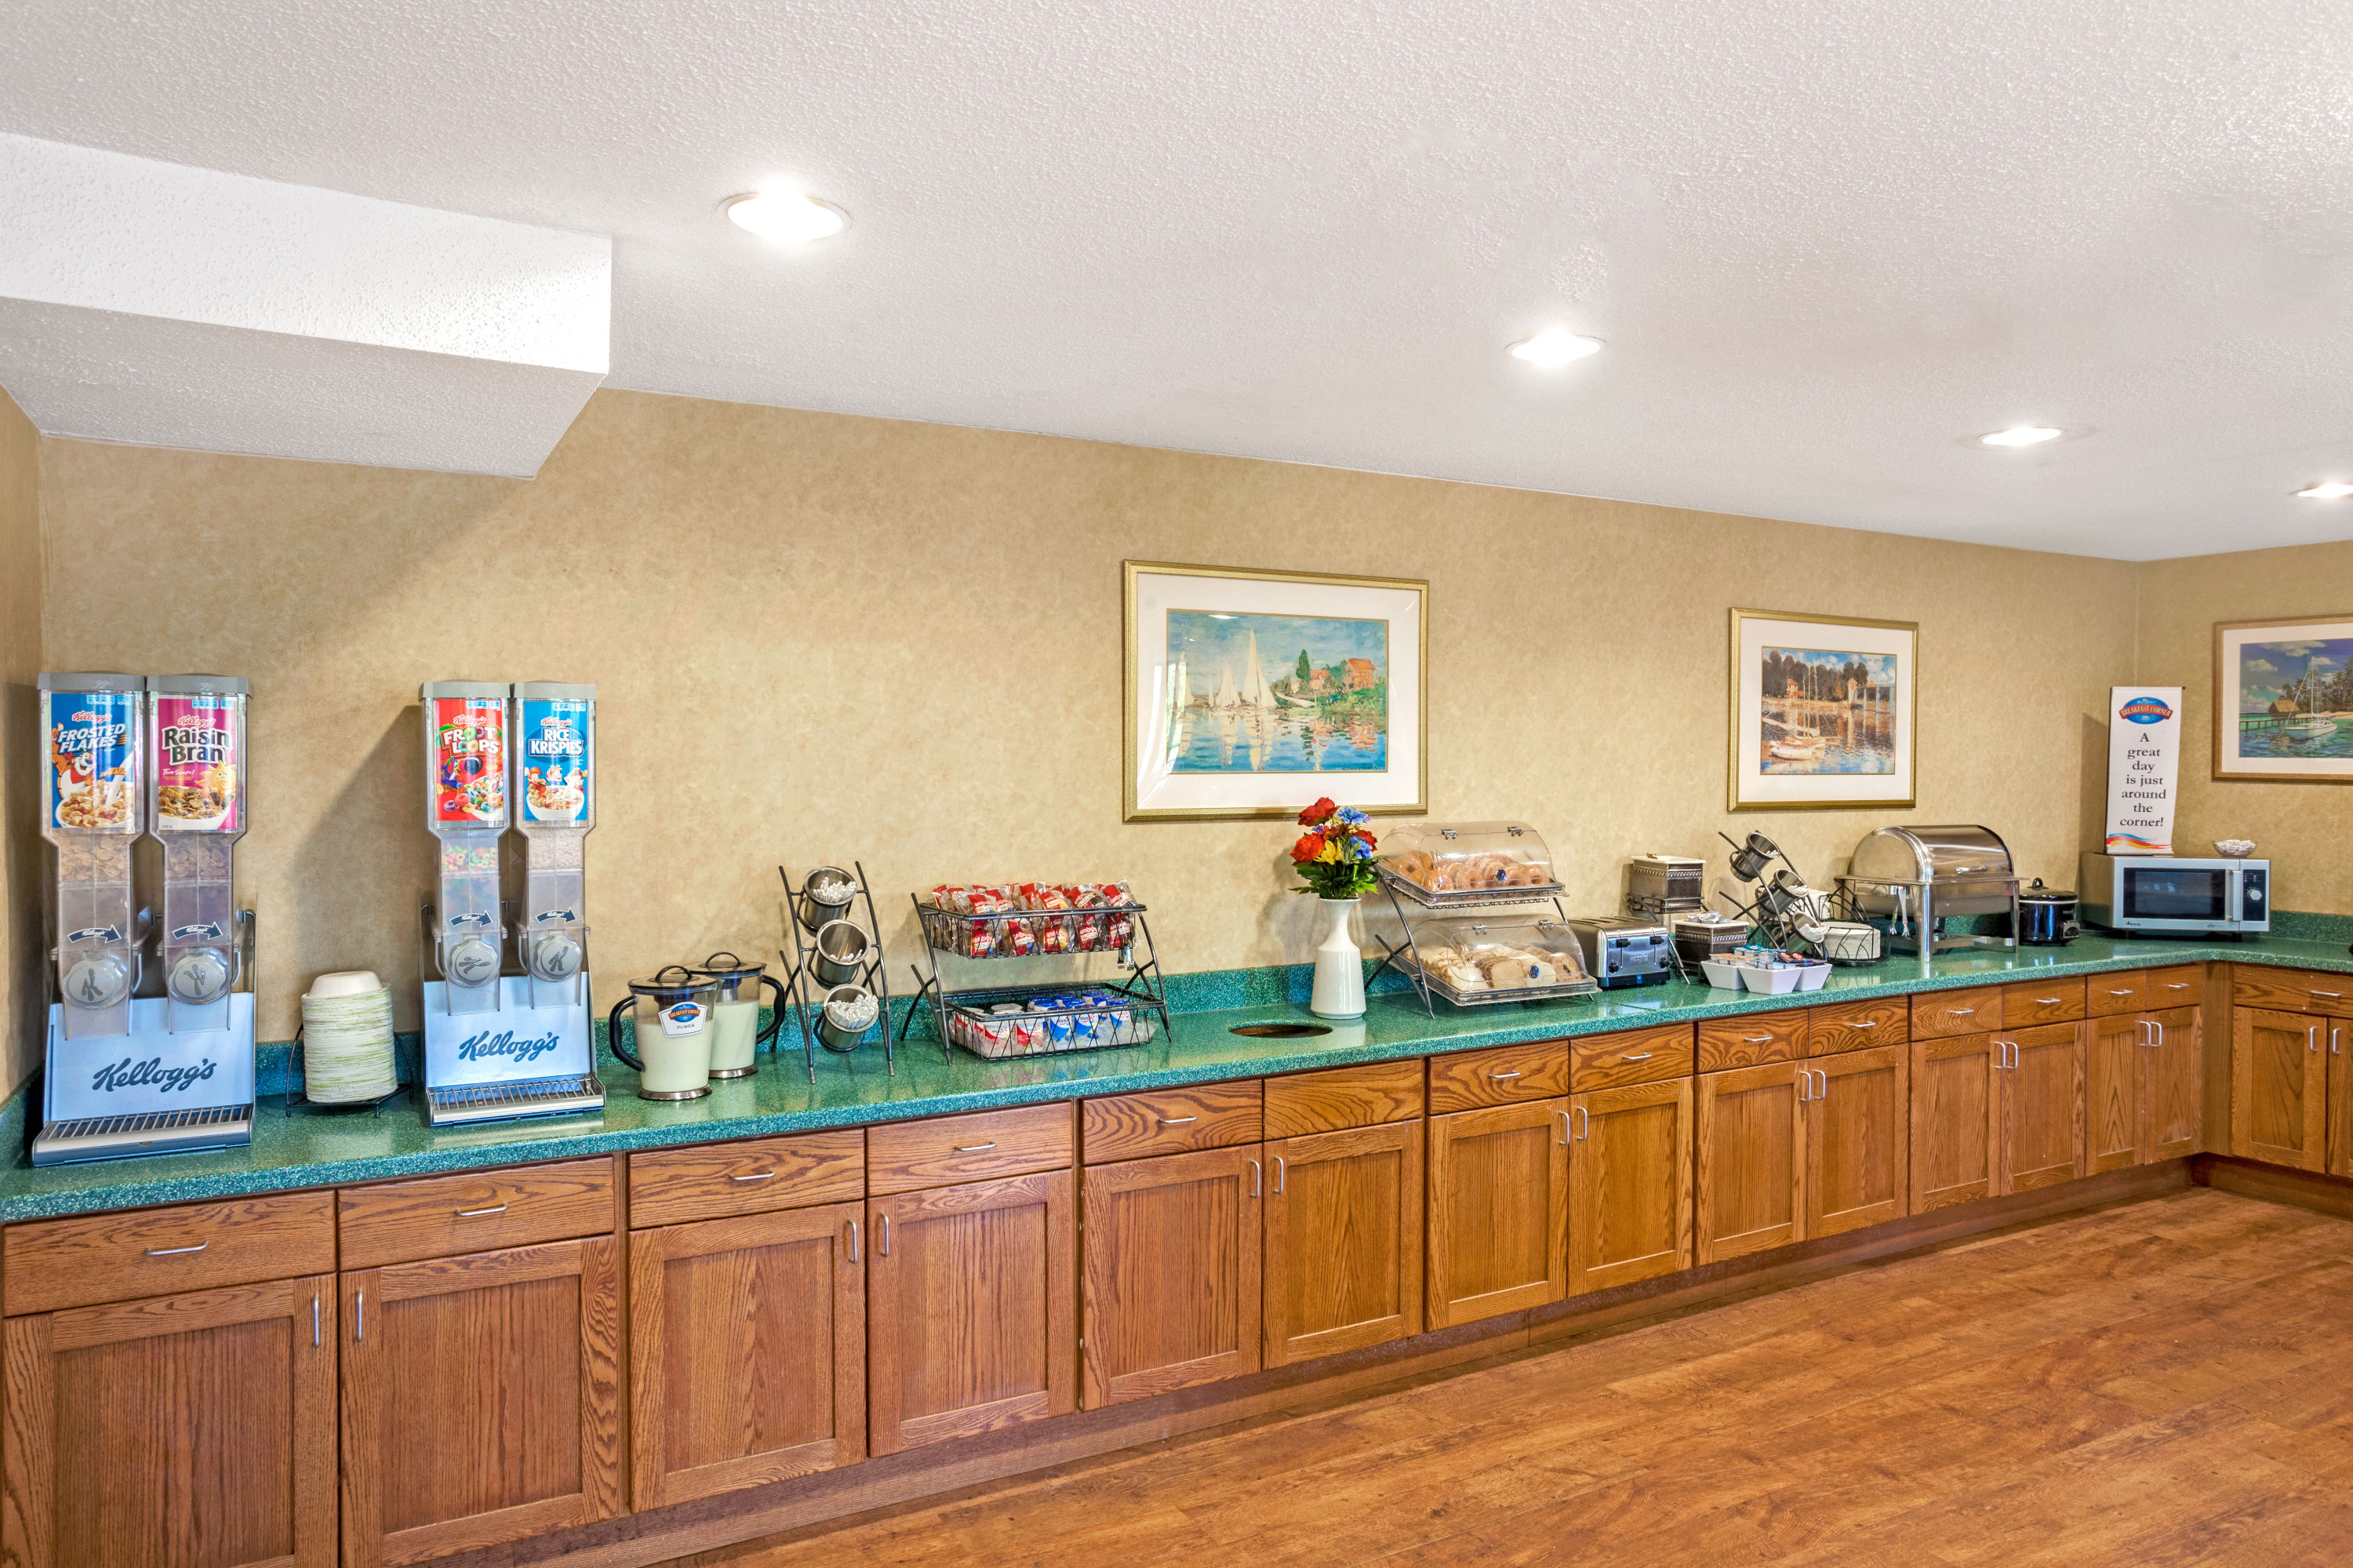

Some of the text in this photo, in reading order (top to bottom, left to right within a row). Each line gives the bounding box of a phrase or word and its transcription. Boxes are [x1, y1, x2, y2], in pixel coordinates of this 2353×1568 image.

[2120, 705, 2172, 716] BREAKFAST CORNER
[57, 724, 125, 743] FROSTED
[163, 727, 231, 748] Raisin
[443, 726, 496, 745] FROOT
[544, 728, 570, 741] RICE
[2140, 733, 2150, 742] A
[60, 735, 117, 754] FLAKES
[452, 739, 500, 754] LOOPS
[531, 740, 583, 755] KRISPIES
[171, 745, 225, 763] Bran
[2127, 748, 2161, 759] great
[2132, 761, 2155, 773] day
[2126, 774, 2163, 787] is just
[2121, 789, 2166, 799] around
[2133, 803, 2153, 813] the
[2119, 817, 2164, 827] corner!
[458, 1030, 559, 1062] Kellogg's
[92, 1057, 217, 1093] Kellogg's
